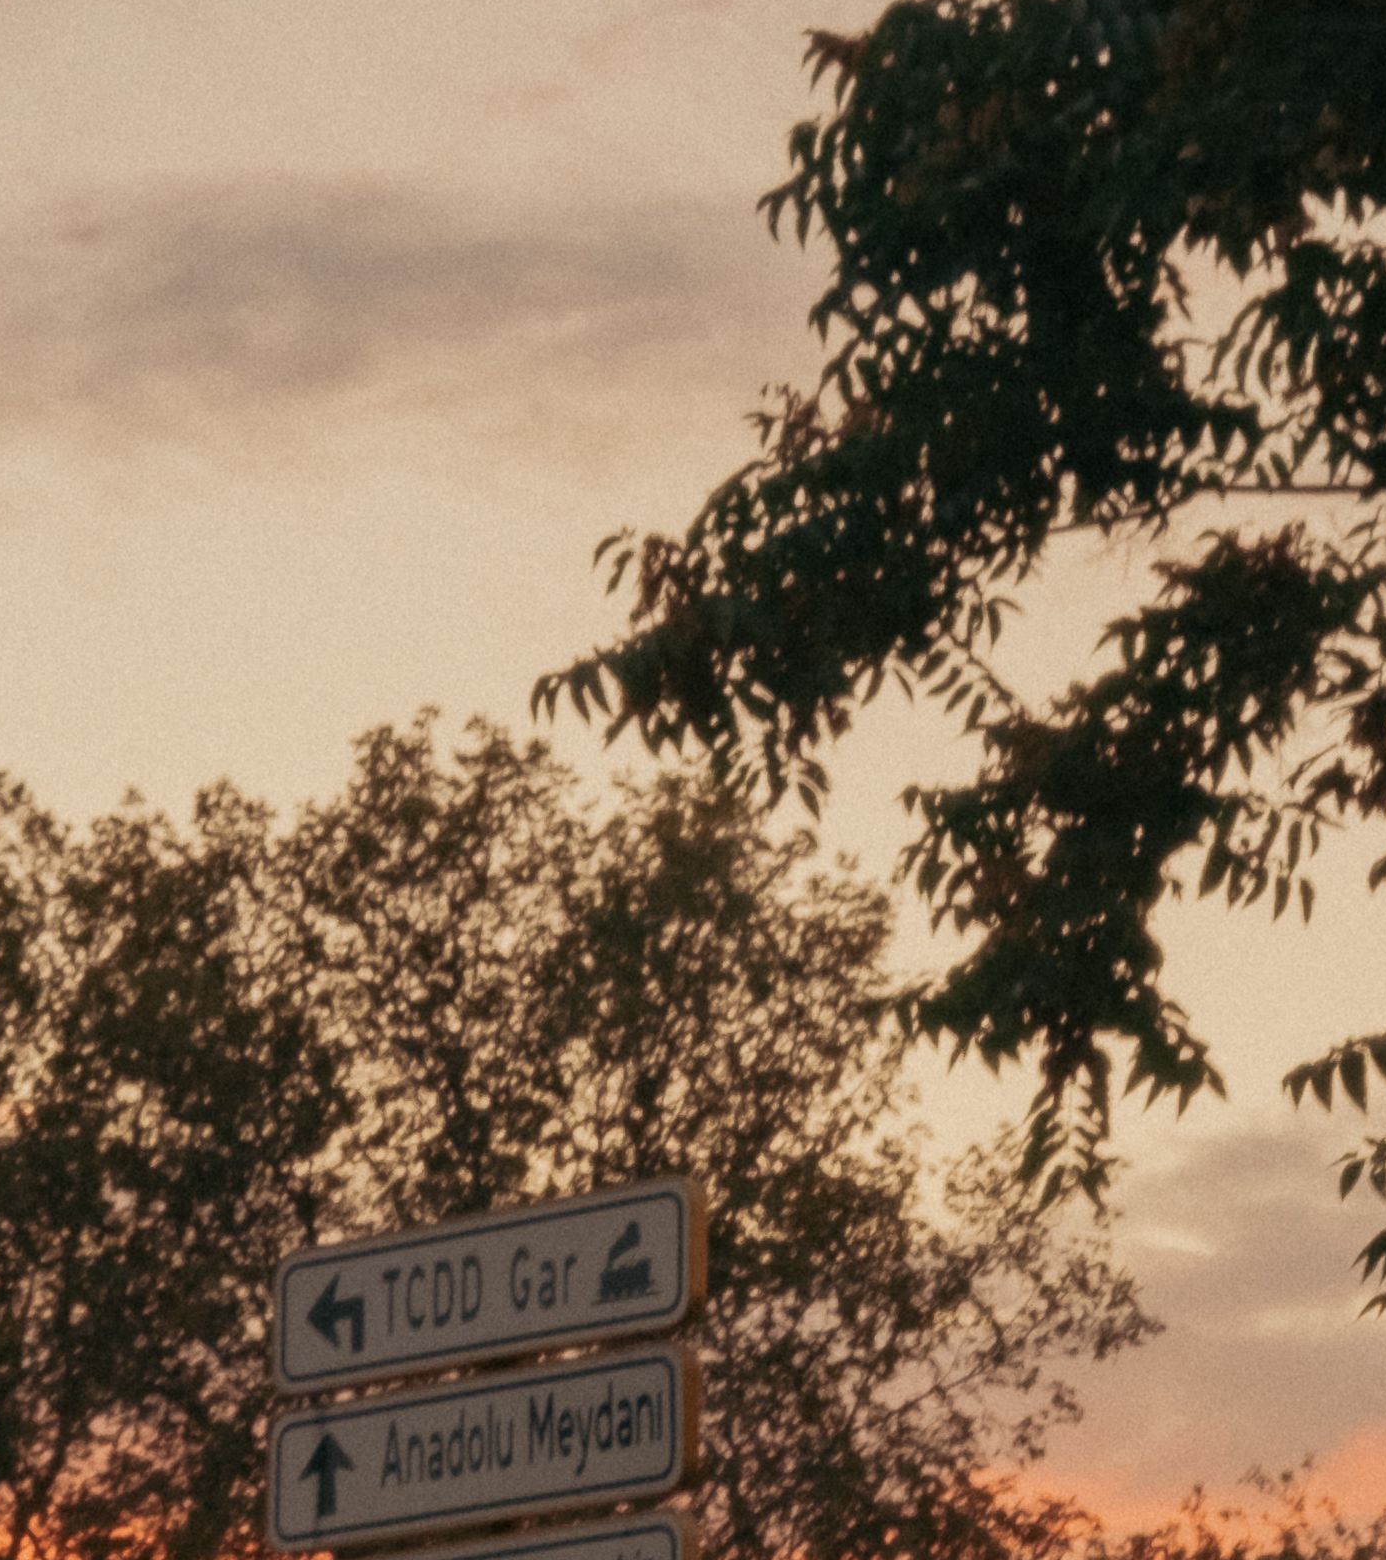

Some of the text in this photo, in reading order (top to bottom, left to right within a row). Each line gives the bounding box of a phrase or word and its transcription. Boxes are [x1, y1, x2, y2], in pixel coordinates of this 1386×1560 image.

[381, 1245, 578, 1337] TCDD Gar
[381, 1380, 664, 1487] Anadolu Meydanı
